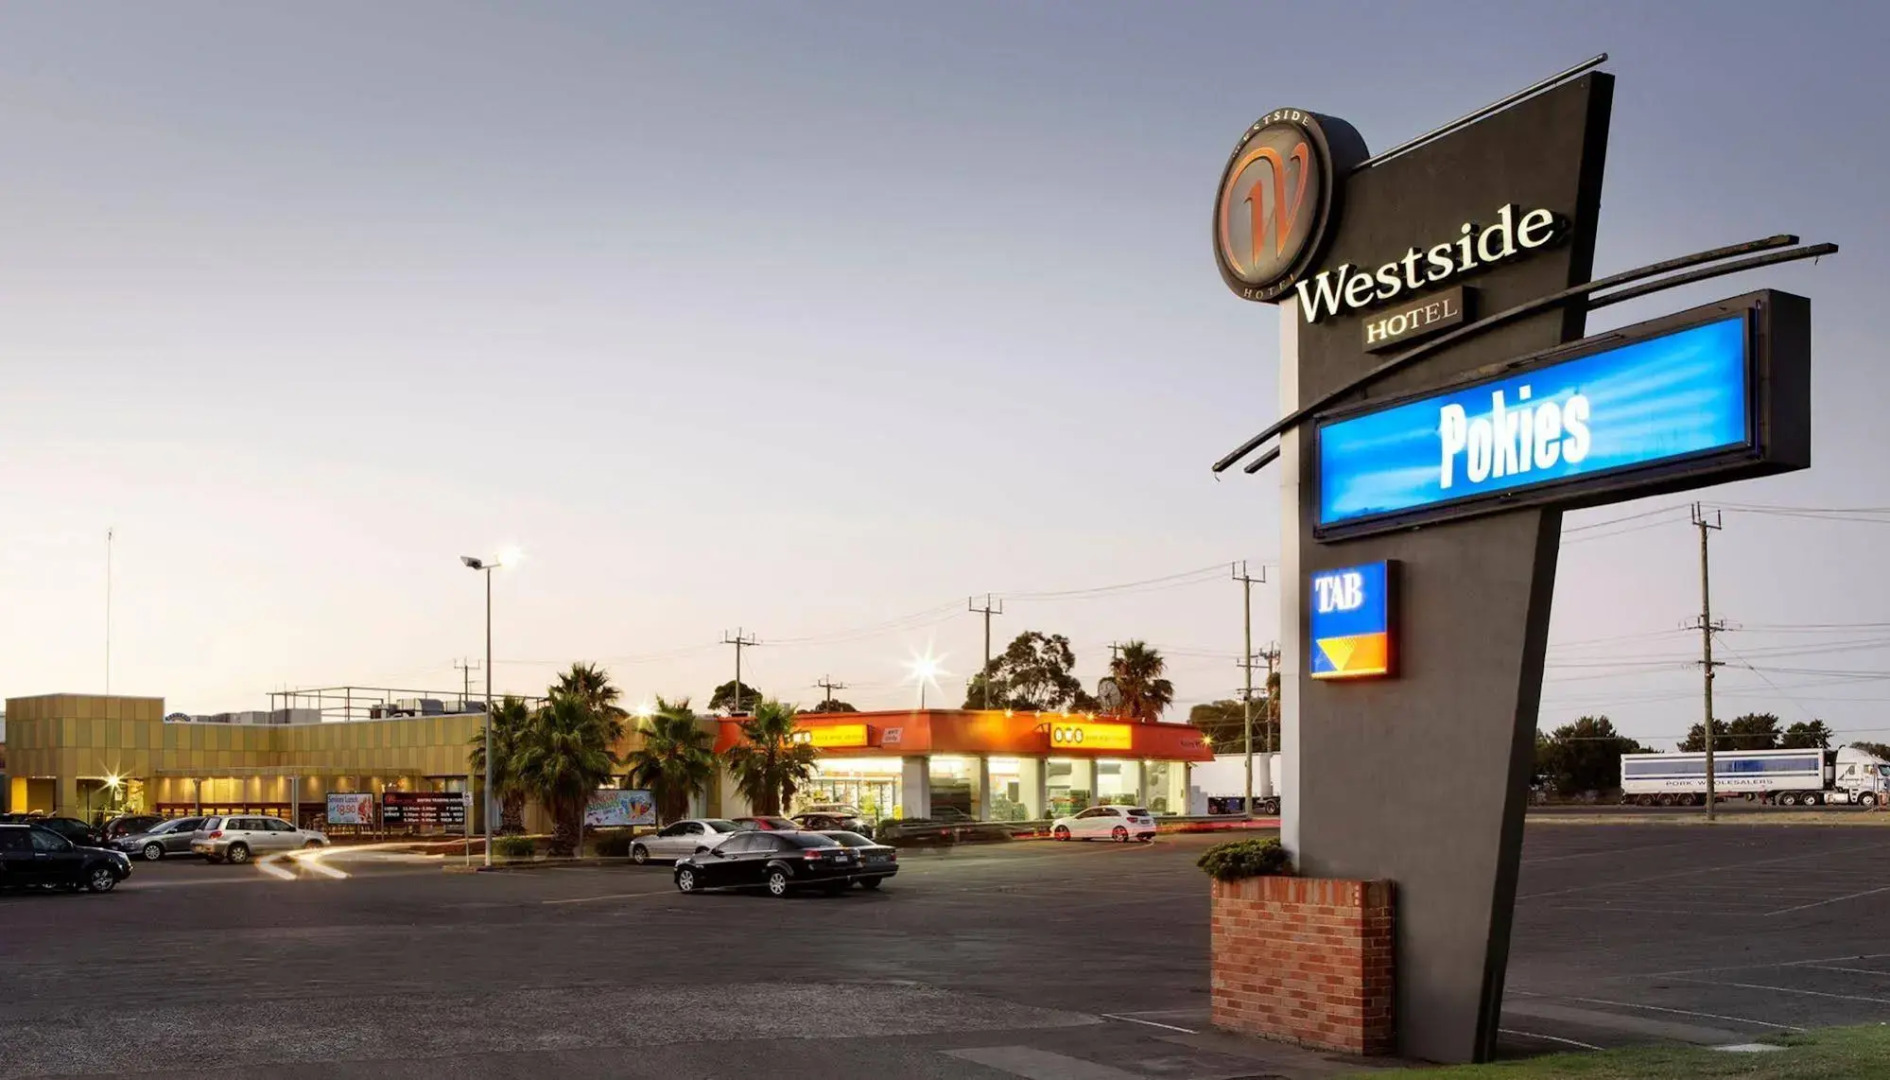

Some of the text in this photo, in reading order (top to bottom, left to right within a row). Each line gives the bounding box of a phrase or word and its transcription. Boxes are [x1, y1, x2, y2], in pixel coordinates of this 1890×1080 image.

[1295, 202, 1554, 324] Westside
[1366, 299, 1459, 344] HOTEL
[1439, 384, 1592, 490] Pokies
[1315, 572, 1363, 614] TAB
[1697, 778, 1774, 787] WOLESALERS
